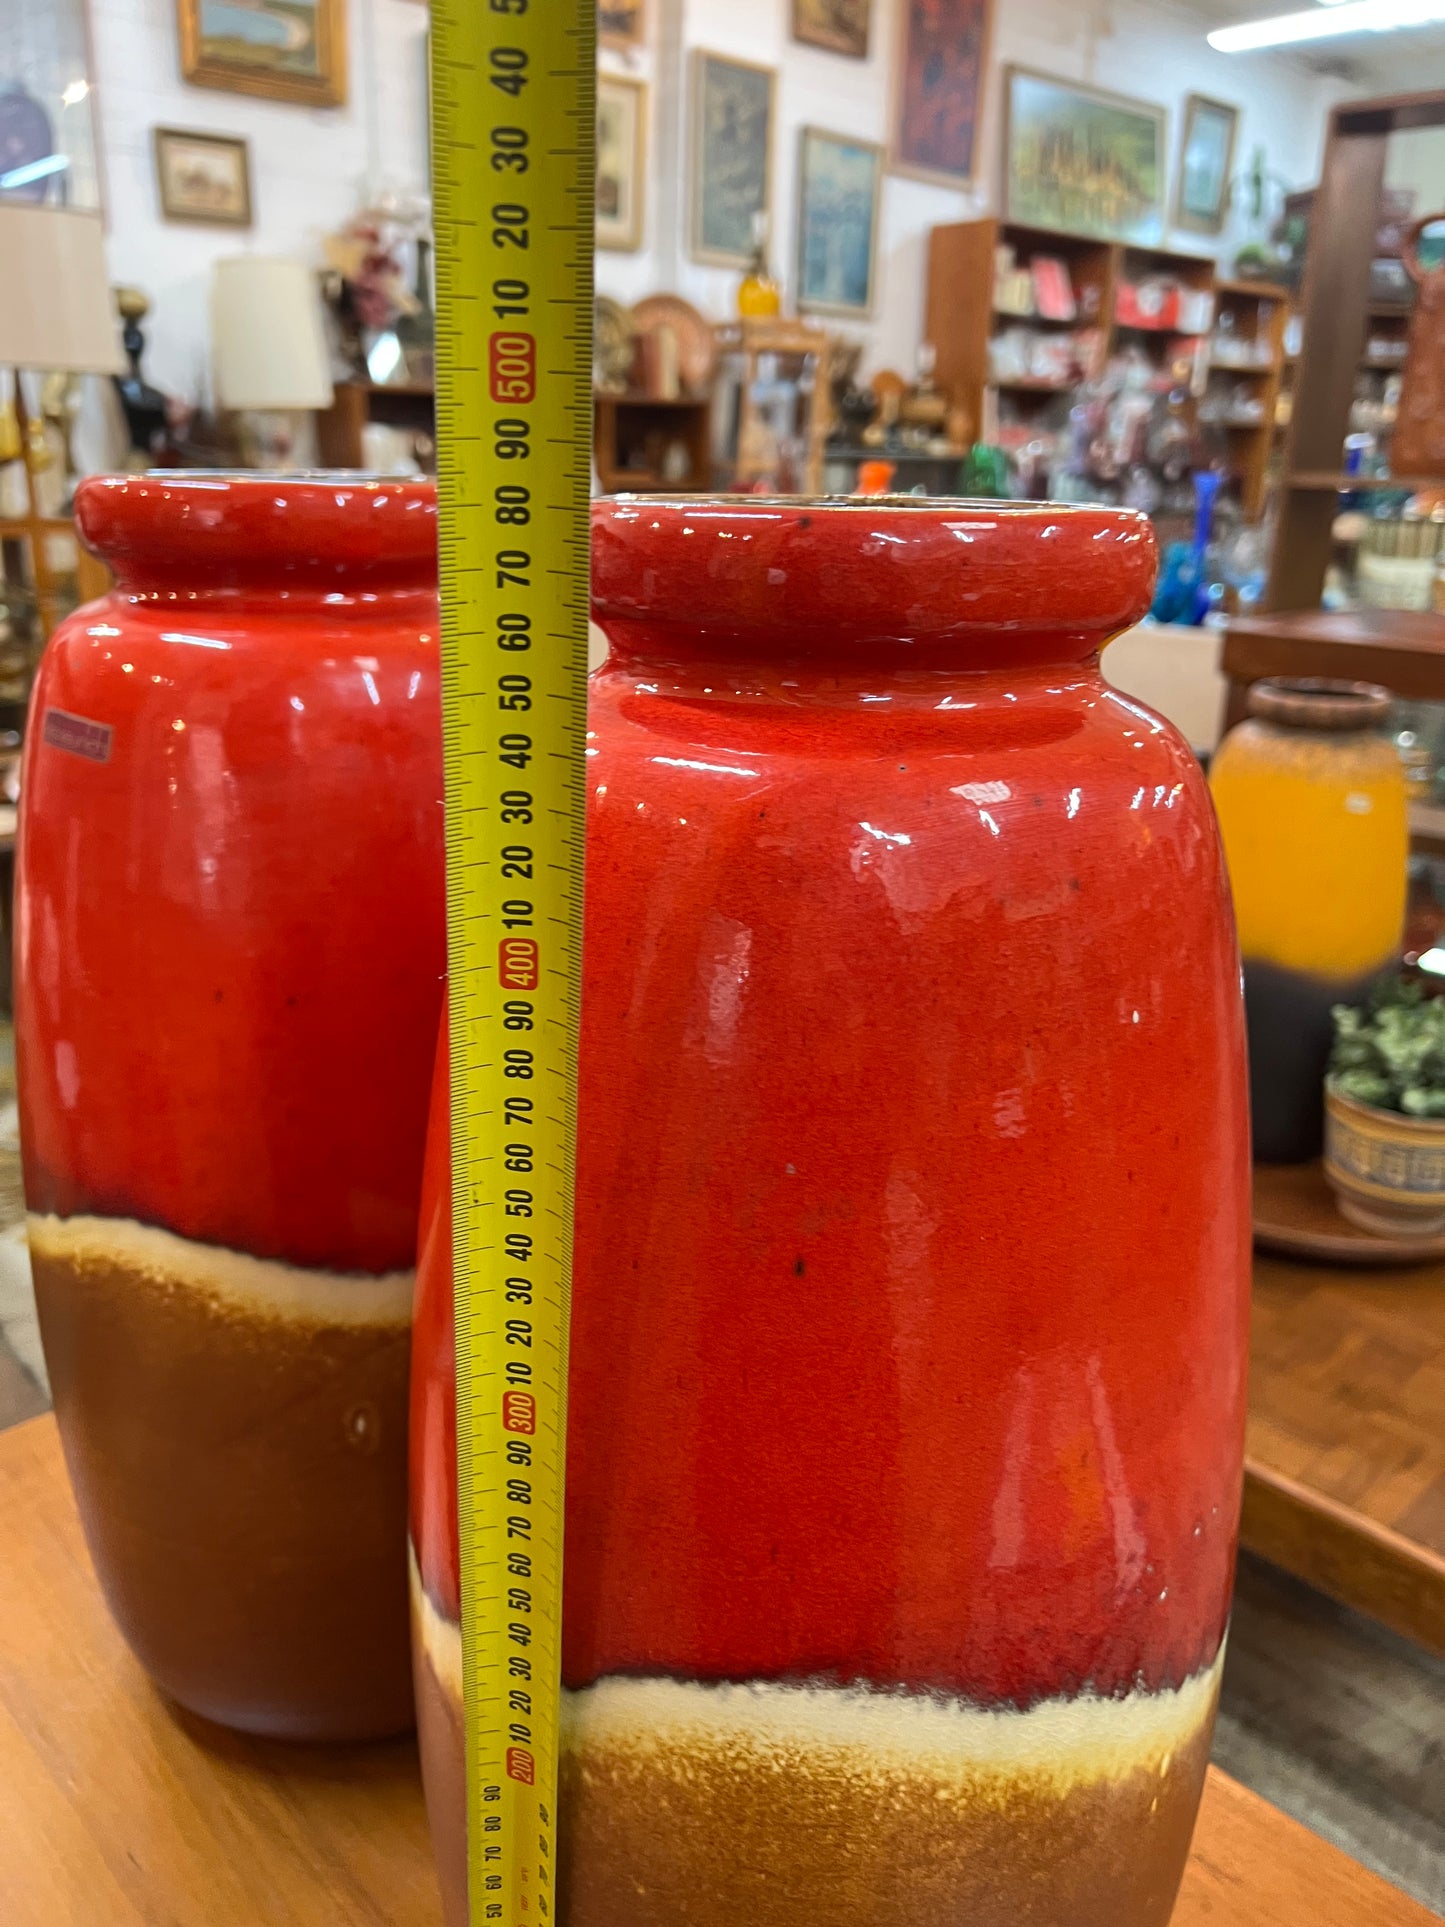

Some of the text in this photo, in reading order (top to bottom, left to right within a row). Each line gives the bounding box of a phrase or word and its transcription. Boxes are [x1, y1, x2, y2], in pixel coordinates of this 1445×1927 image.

[490, 47, 529, 97] 40
[491, 127, 529, 174] 30
[491, 204, 530, 250] 20
[492, 279, 530, 319] 10
[495, 337, 531, 398] 500
[494, 418, 531, 460] 90
[495, 485, 531, 526] 80
[496, 550, 532, 589] 70
[497, 613, 532, 652] 60
[497, 674, 532, 712] 50
[498, 733, 533, 770] 40
[500, 790, 533, 825] 30
[501, 845, 534, 881] 20
[501, 899, 534, 930] 10
[504, 941, 534, 986] 400
[502, 1000, 534, 1031] 90
[503, 1049, 534, 1081] 80
[503, 1097, 534, 1126] 70
[504, 1143, 534, 1173] 60
[504, 1189, 534, 1218] 50
[504, 1233, 534, 1263] 40
[504, 1277, 534, 1305] 30
[505, 1319, 534, 1348] 20
[506, 1361, 534, 1386] 10
[508, 1394, 533, 1431] 300
[506, 1440, 533, 1467] 90
[506, 1478, 533, 1505] 80
[506, 1516, 533, 1542] 70
[507, 1552, 533, 1578] 60
[507, 1587, 533, 1614] 50
[507, 1622, 533, 1648] 40
[508, 1656, 532, 1682] 30
[508, 1689, 532, 1716] 20
[508, 1723, 532, 1744] 10
[511, 1749, 533, 1783] 200
[483, 1785, 501, 1802] 90
[484, 1816, 502, 1832] 80
[484, 1846, 502, 1862] 70
[485, 1875, 502, 1890] 60
[486, 1903, 503, 1919] 50
